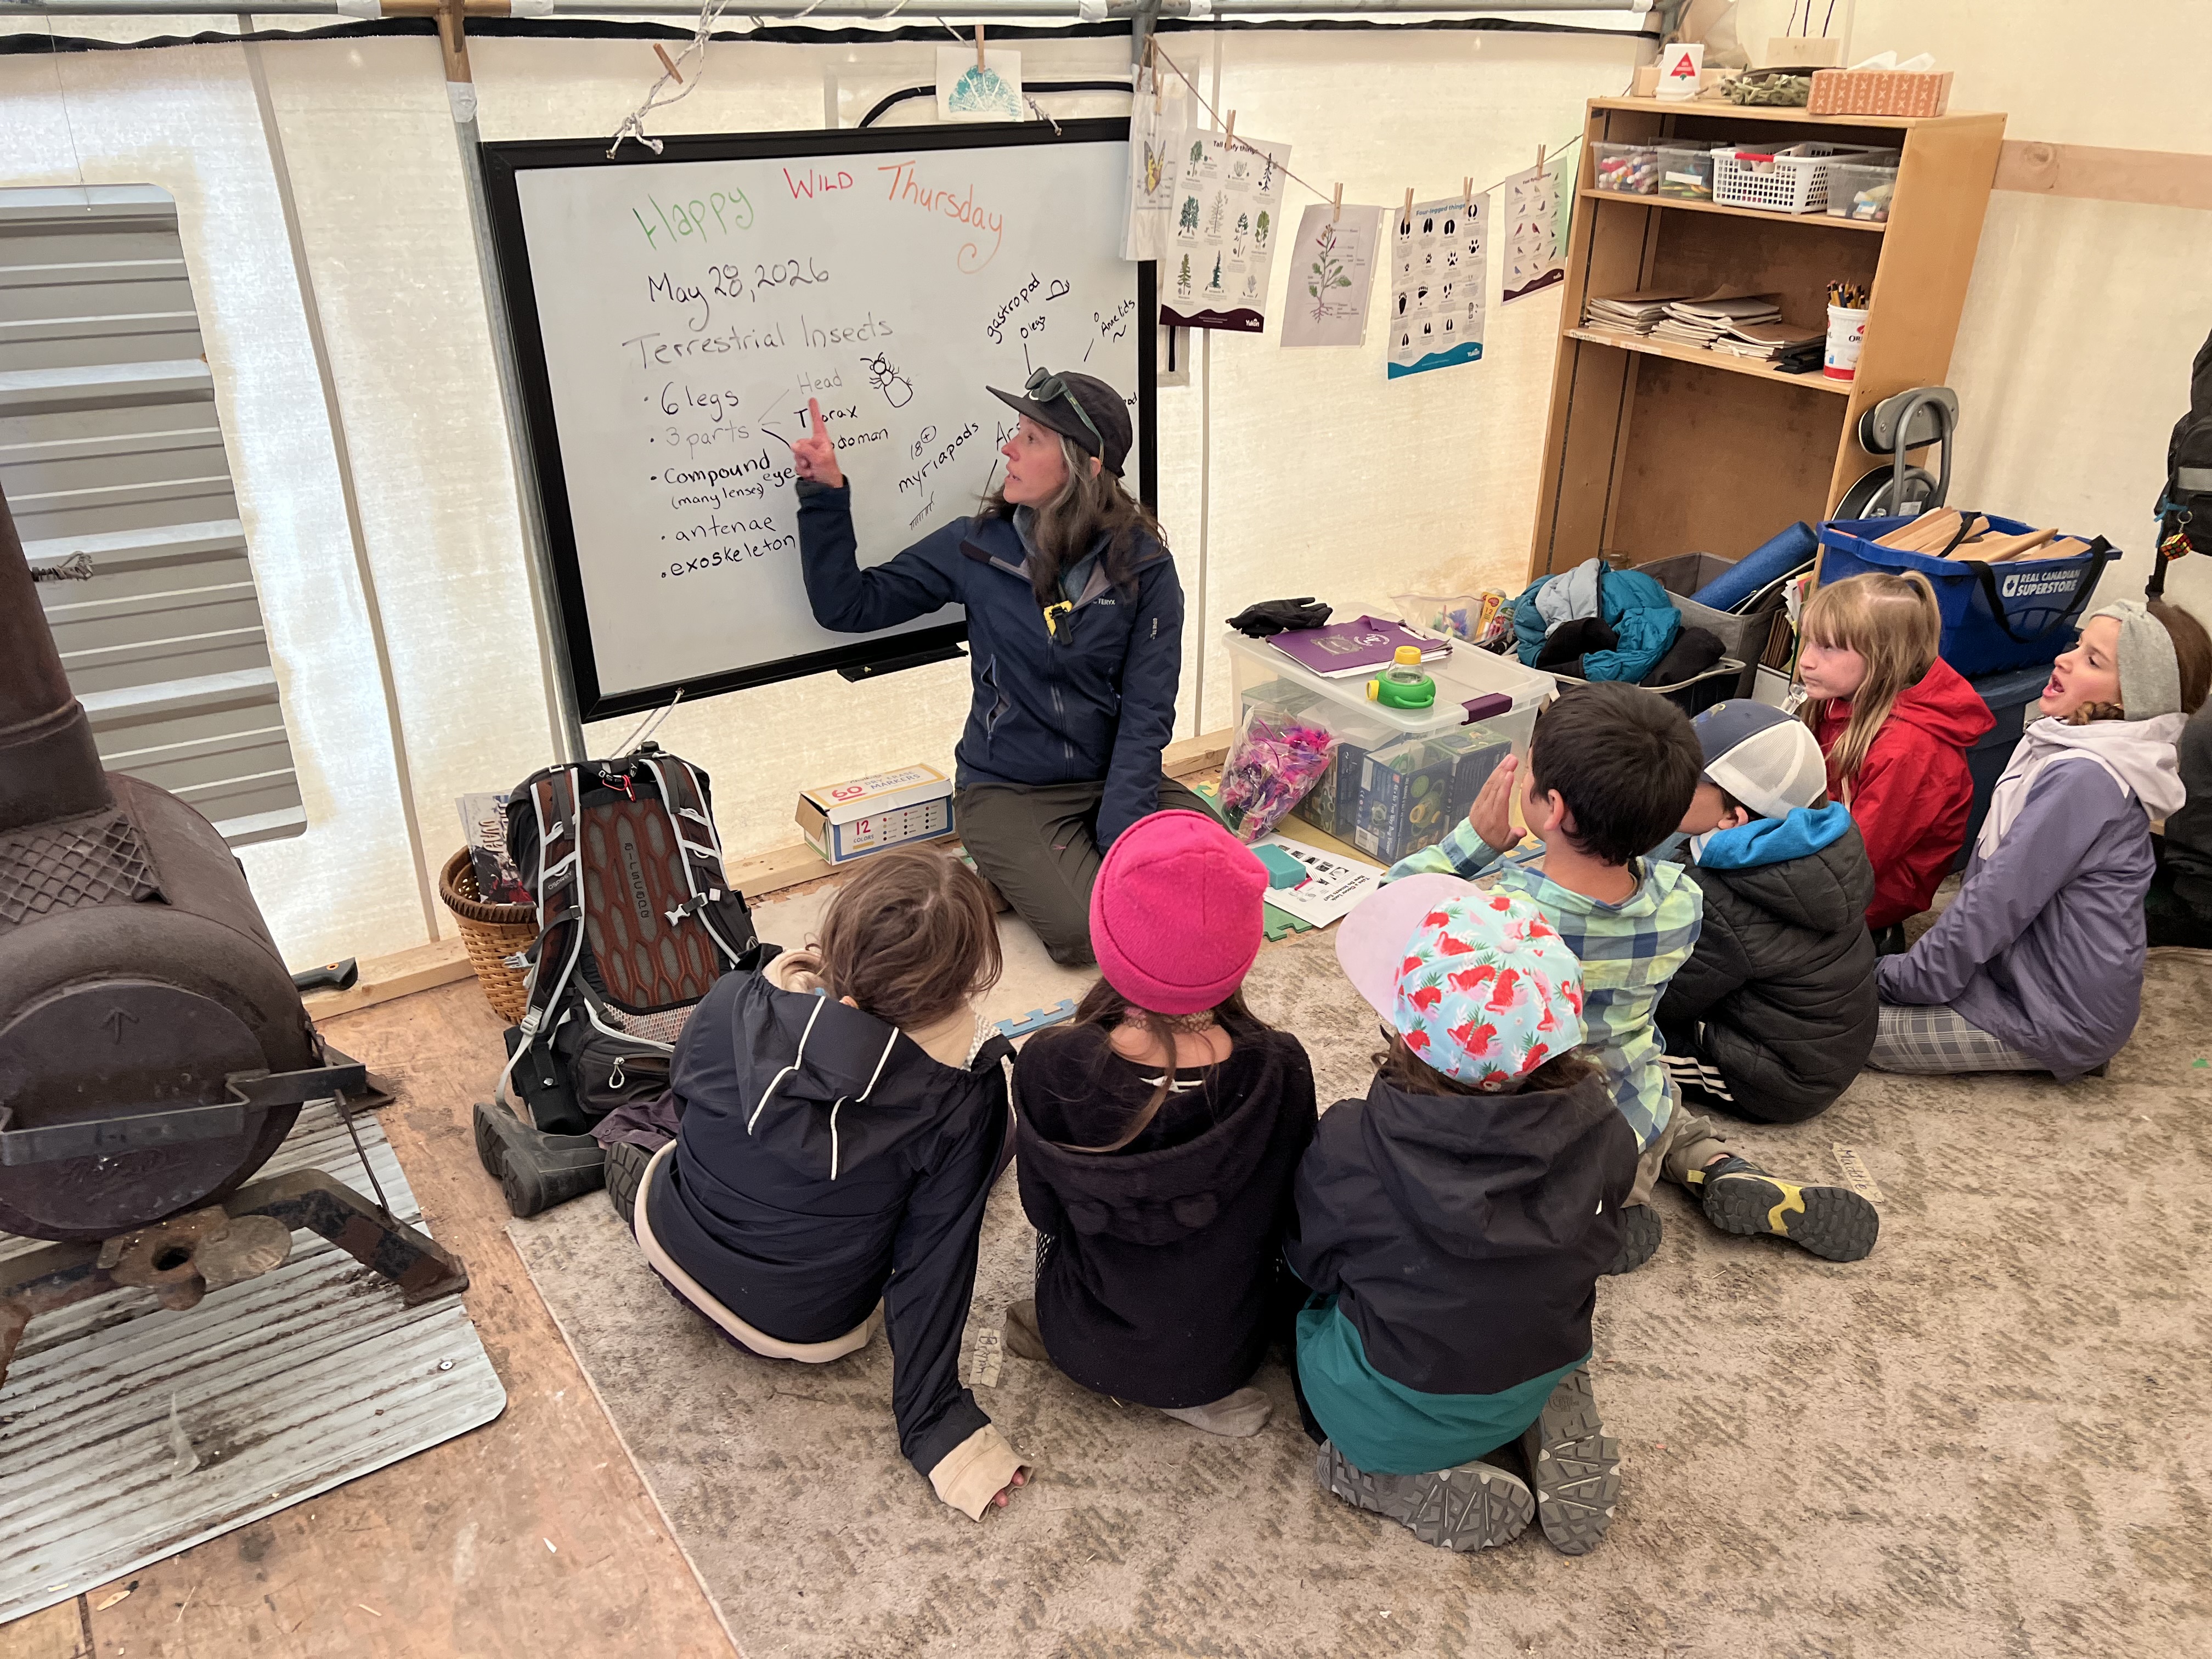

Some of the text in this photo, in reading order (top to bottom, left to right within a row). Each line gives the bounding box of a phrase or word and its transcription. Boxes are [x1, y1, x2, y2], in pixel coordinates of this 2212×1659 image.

[1224, 142, 1239, 152] lfy
[1239, 145, 1257, 155] thing
[633, 160, 1003, 274] Happy WILD Thursday
[1415, 204, 1448, 216] Four-legged
[648, 274, 710, 331] May
[987, 272, 1040, 345] gastropod
[1029, 314, 1046, 331] legs
[1245, 319, 1260, 328] Yukon
[623, 312, 893, 370] Terrestrial Insects
[797, 368, 843, 395] Head
[793, 404, 859, 428] Torax
[686, 420, 750, 460] parts
[664, 449, 797, 488] Compound eye
[899, 423, 979, 498] myriapods
[671, 492, 721, 510] (many
[675, 515, 776, 541] antenae
[670, 534, 796, 577] exoskeleton
[2020, 569, 2082, 583] REAL CANADIAN
[2016, 579, 2078, 596] SUPERSTORE
[598, 763, 637, 783] OSEY
[887, 771, 915, 780] ERASE
[832, 786, 863, 798] 60
[870, 774, 921, 789] MARKERS
[856, 819, 871, 836] 12
[853, 834, 874, 844] COLORS
[547, 871, 573, 891] OSPREY
